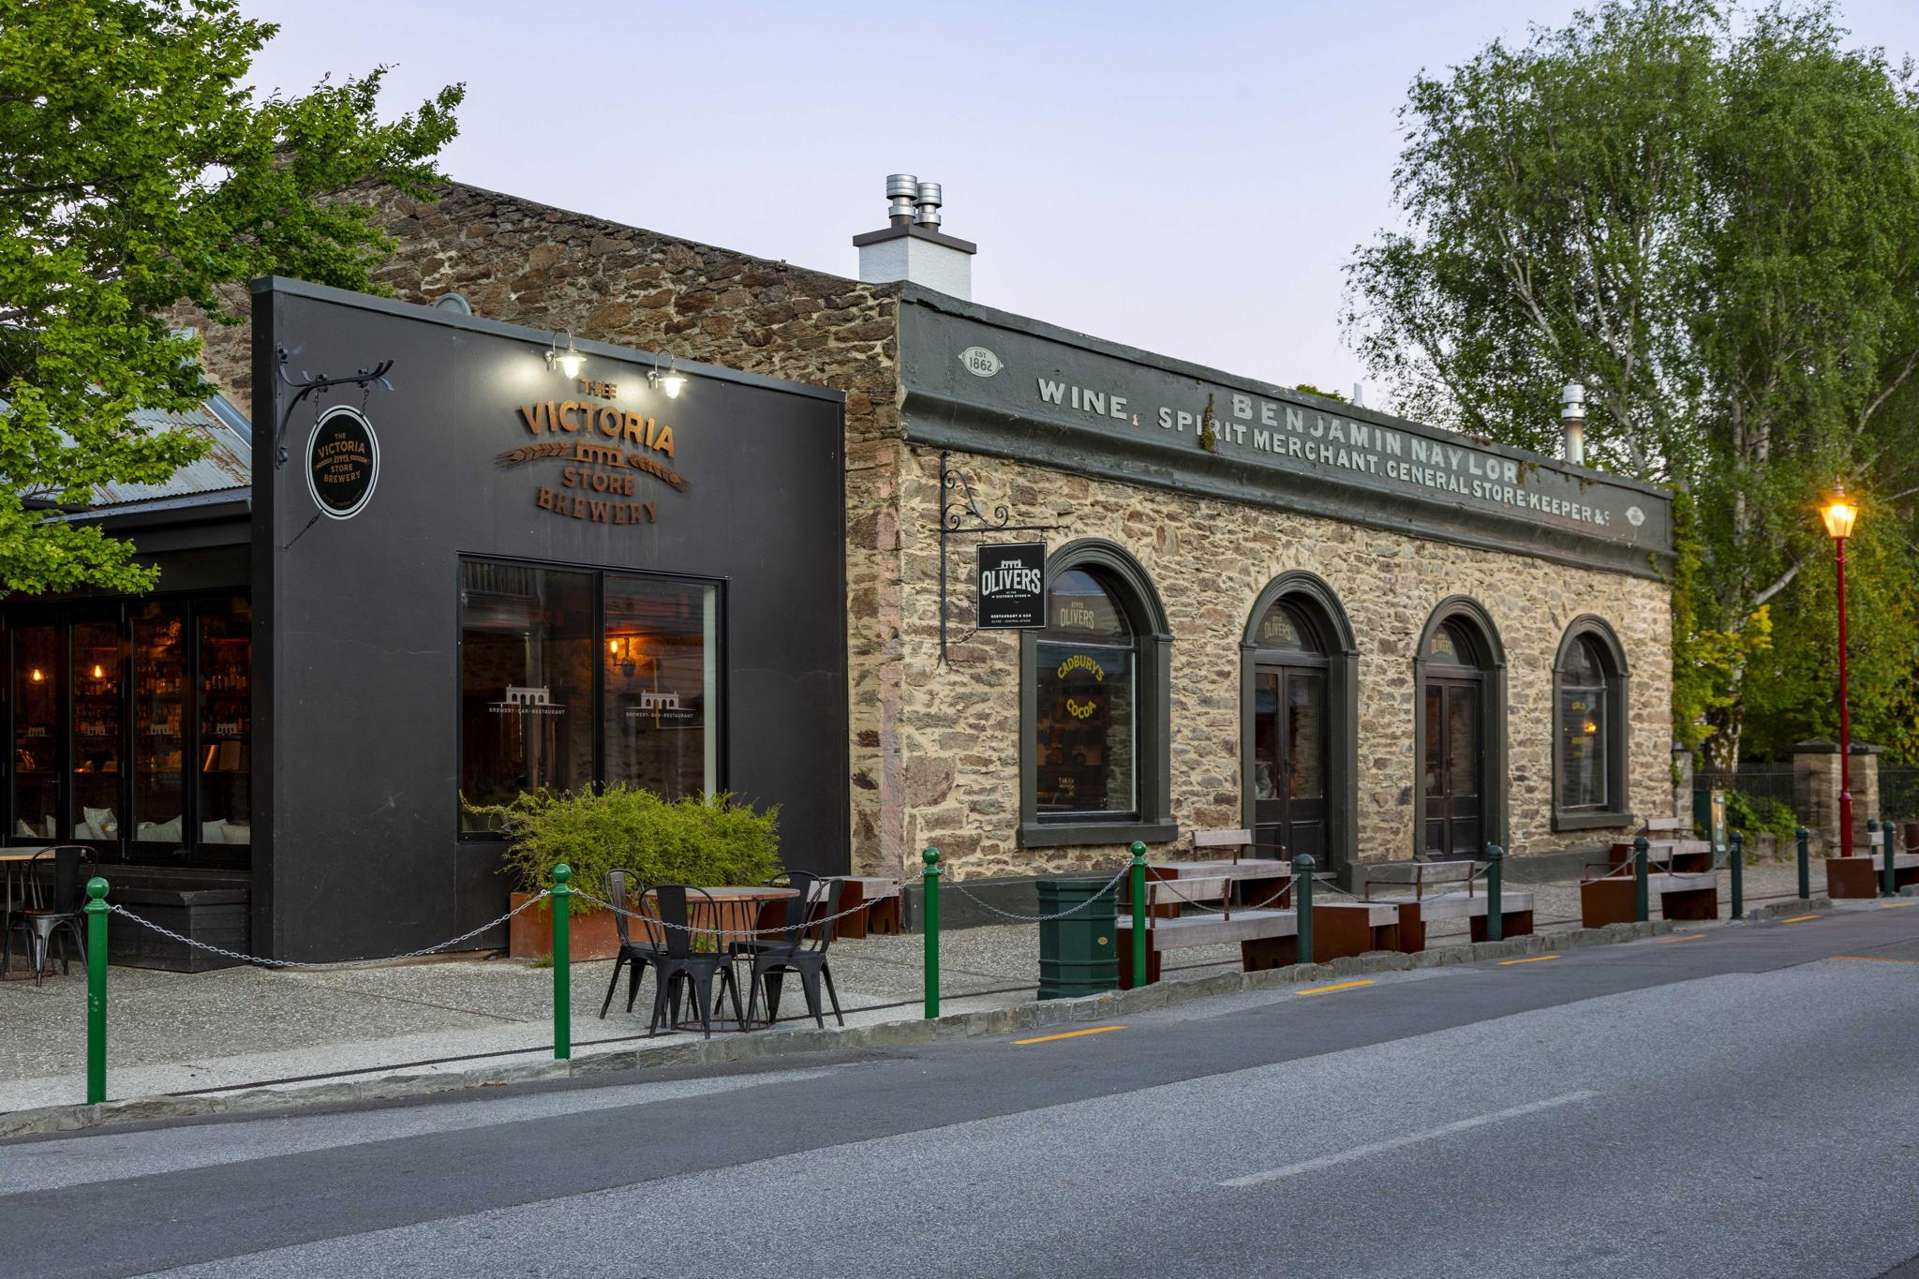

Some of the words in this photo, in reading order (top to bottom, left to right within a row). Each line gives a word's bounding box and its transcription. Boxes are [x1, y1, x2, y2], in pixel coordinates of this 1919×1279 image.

[969, 357, 993, 372] 1862
[974, 350, 986, 359] EST
[580, 378, 618, 400] THE
[334, 432, 347, 440] THE
[520, 400, 676, 459] VICTORIA
[1232, 394, 1401, 456] BENJAMIN
[1411, 438, 1518, 484] NAYLOR
[317, 440, 366, 458] VICTORIA
[1158, 406, 1247, 445] SPIRIT
[1387, 460, 1469, 494] GENERAL
[323, 470, 361, 484] BREWERY
[330, 463, 353, 473] STORE
[562, 464, 637, 497] STORE
[536, 485, 657, 525] BREWERY
[981, 568, 1041, 597] OLIVERS
[1060, 607, 1095, 630] OLIVERS
[1066, 698, 1097, 720] COCOA
